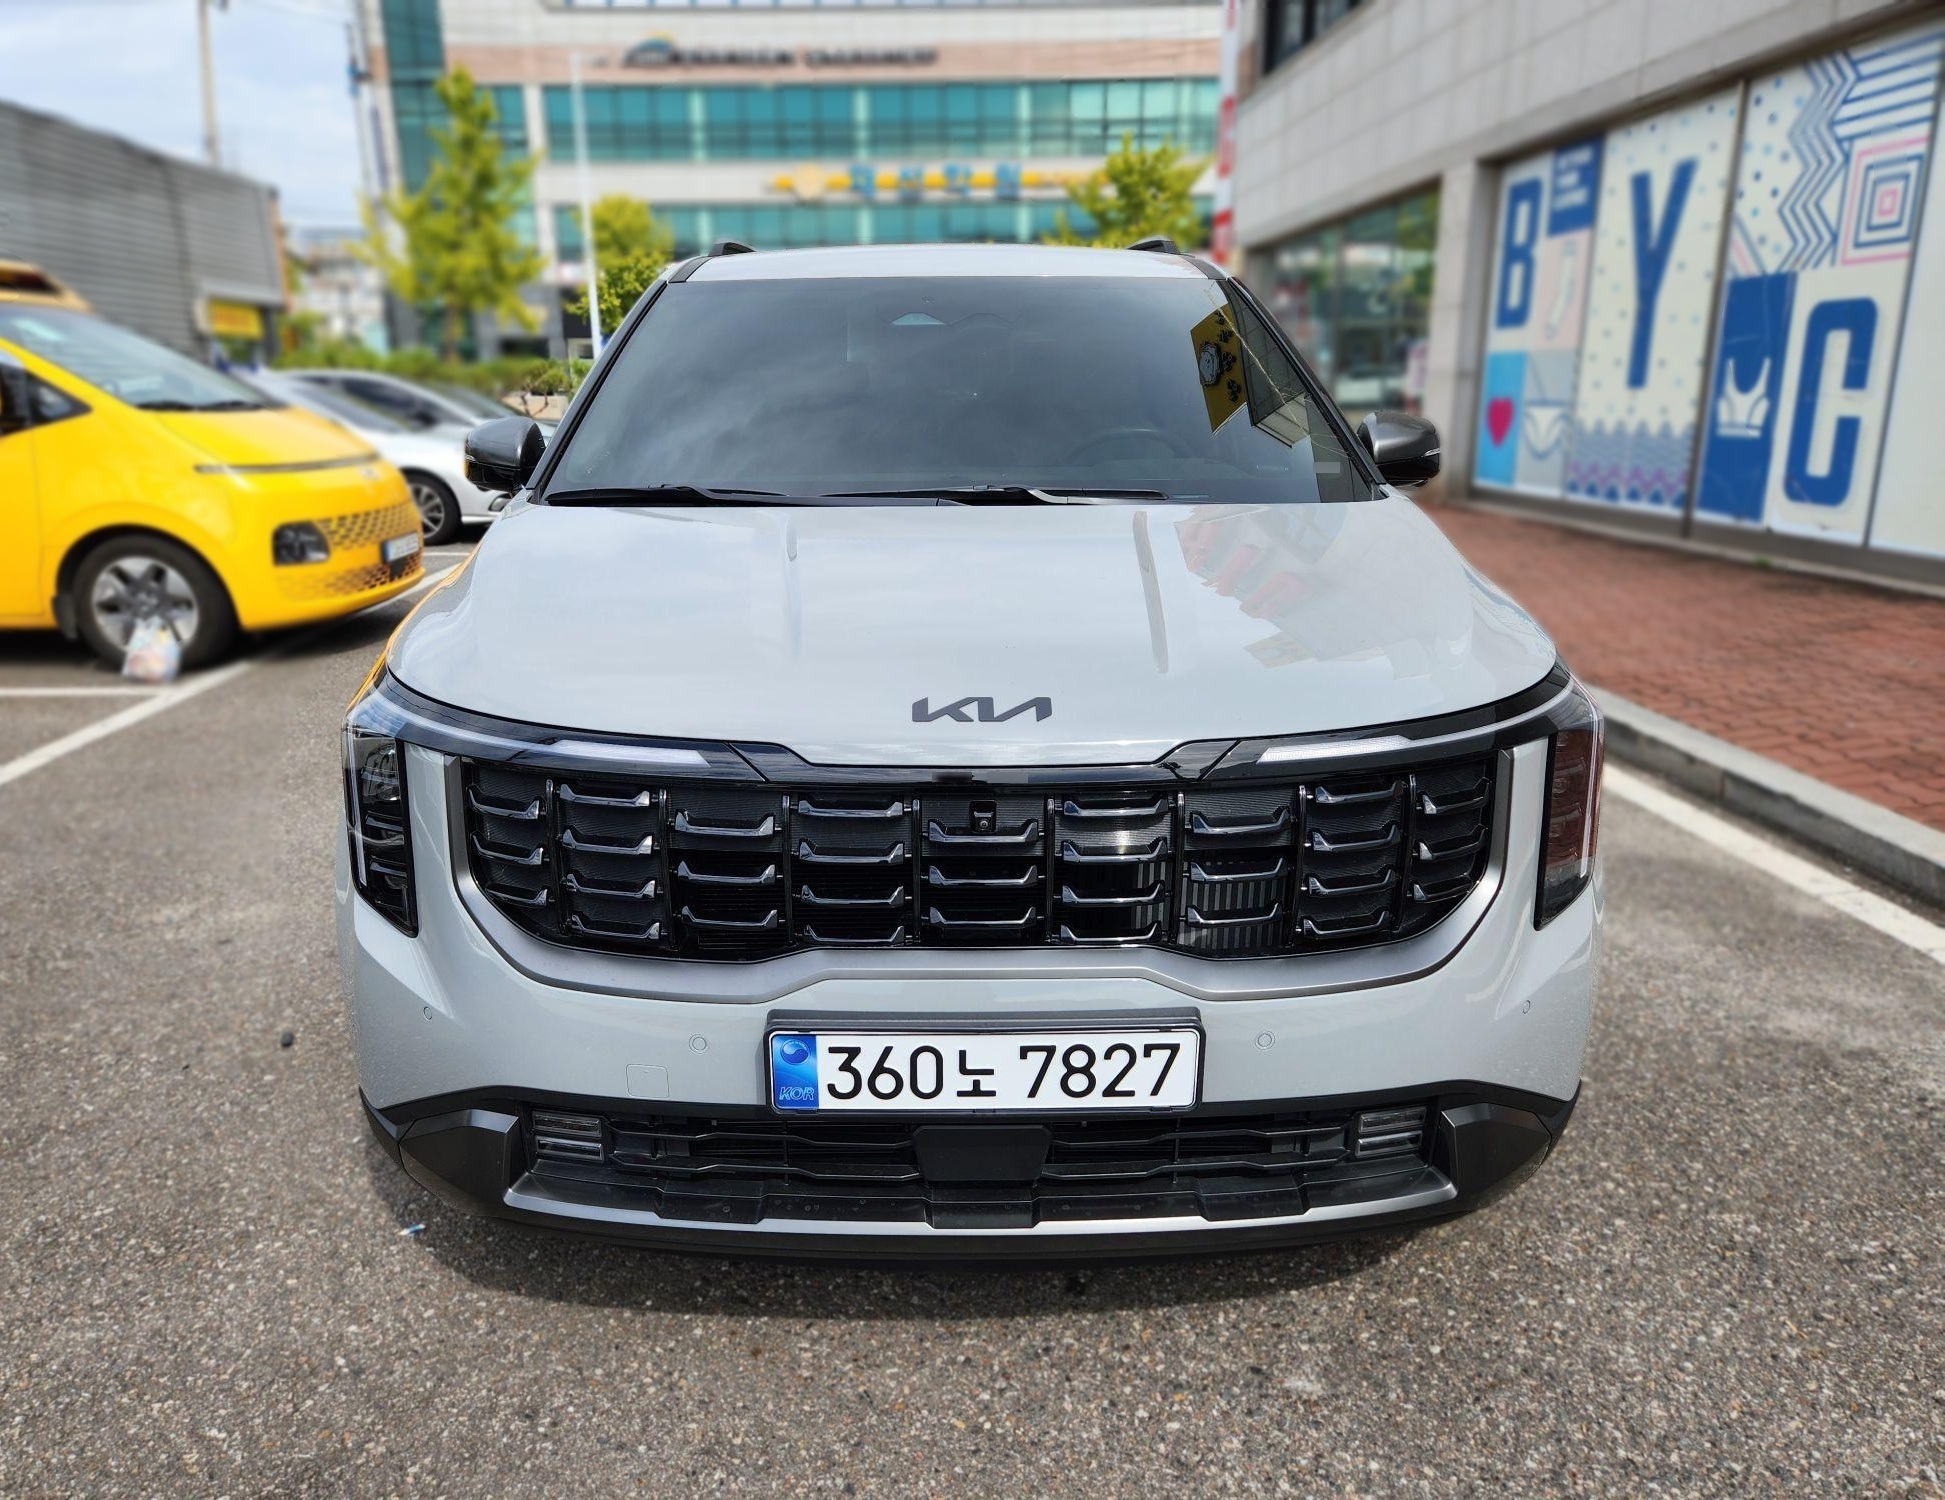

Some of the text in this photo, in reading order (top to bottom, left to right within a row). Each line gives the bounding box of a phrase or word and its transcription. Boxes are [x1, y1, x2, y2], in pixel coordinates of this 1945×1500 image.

[912, 696, 1052, 722] KIA
[826, 1042, 1181, 1101] 360노 7827
[779, 1086, 815, 1101] KOR
